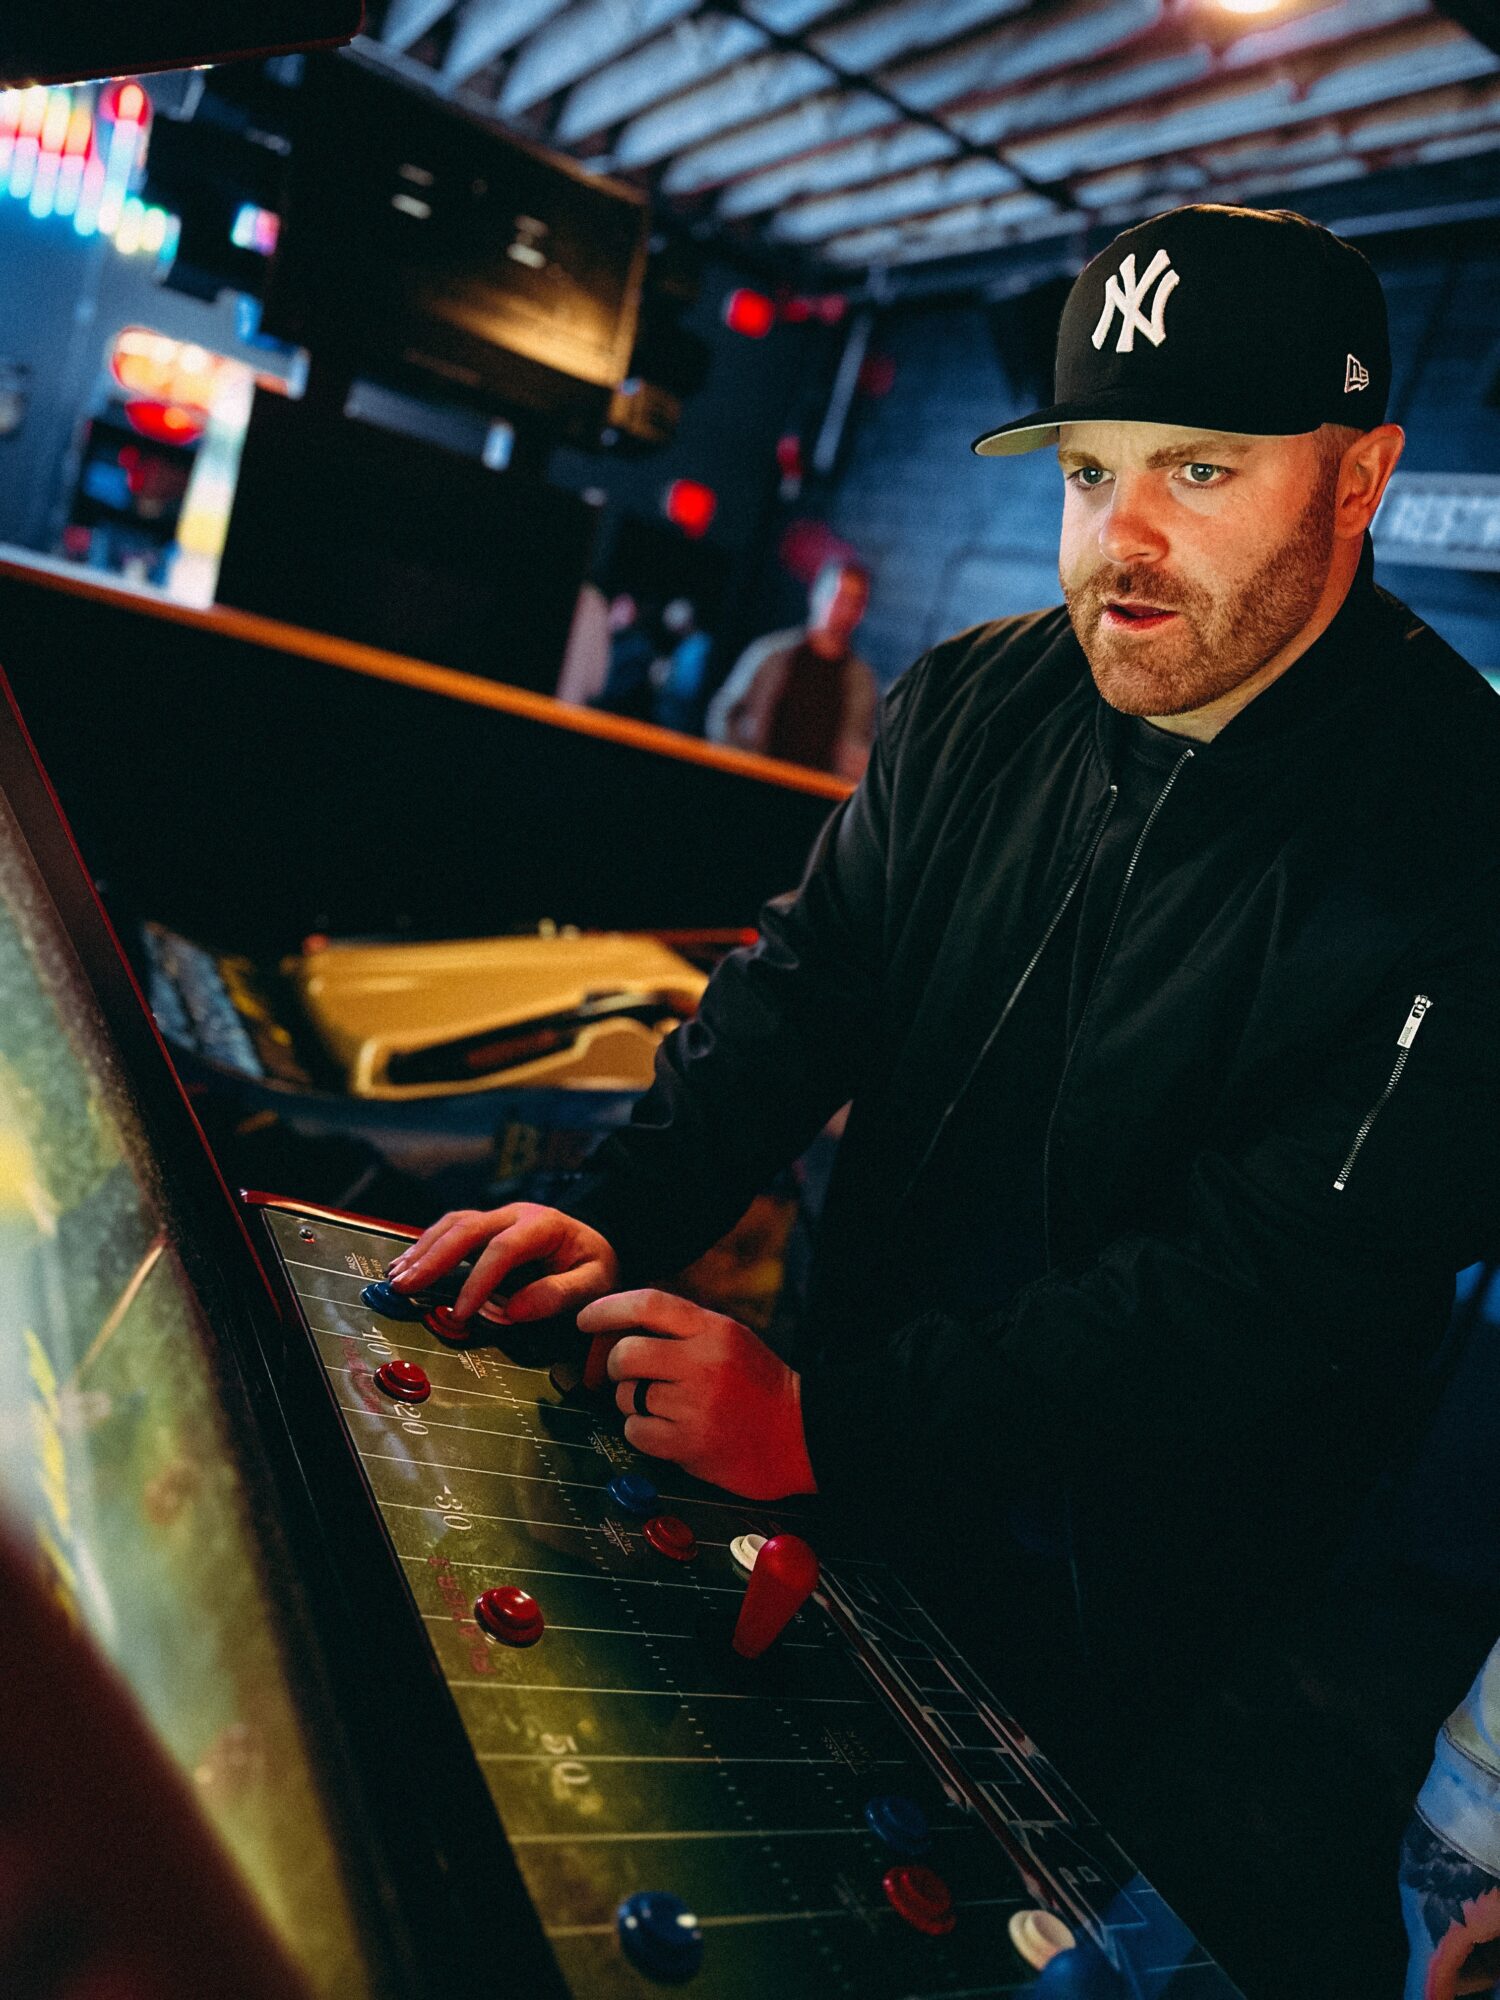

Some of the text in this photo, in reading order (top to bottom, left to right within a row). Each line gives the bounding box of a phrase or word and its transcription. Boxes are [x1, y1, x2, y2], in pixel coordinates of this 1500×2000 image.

[1091, 248, 1180, 353] NY
[362, 1329, 393, 1355] 10
[393, 1403, 429, 1435] 20
[434, 1495, 472, 1530] 30
[541, 1733, 592, 1785] 50
